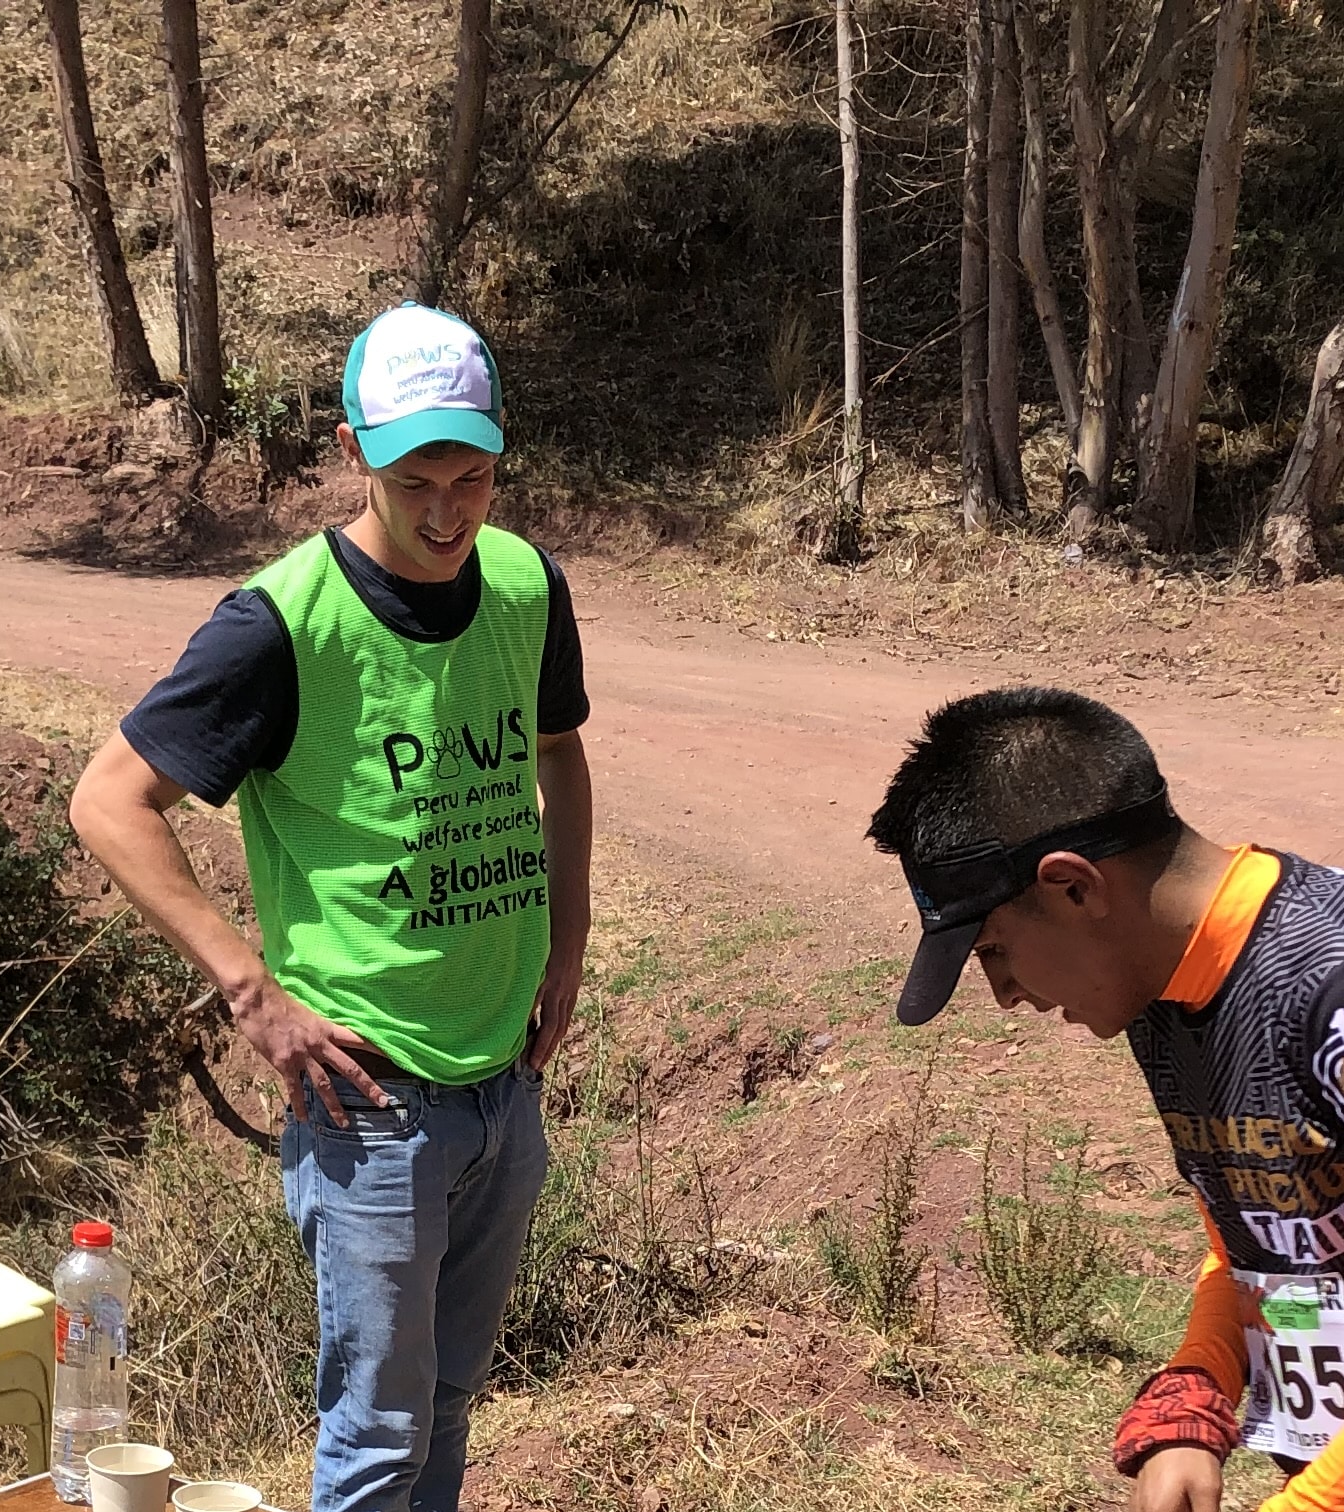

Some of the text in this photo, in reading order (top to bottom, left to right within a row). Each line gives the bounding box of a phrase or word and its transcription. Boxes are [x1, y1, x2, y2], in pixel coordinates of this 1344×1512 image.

[414, 774, 522, 818] Peru Animal
[485, 805, 540, 835] Society
[378, 866, 414, 899] A
[410, 886, 546, 930] INITIATIVE
